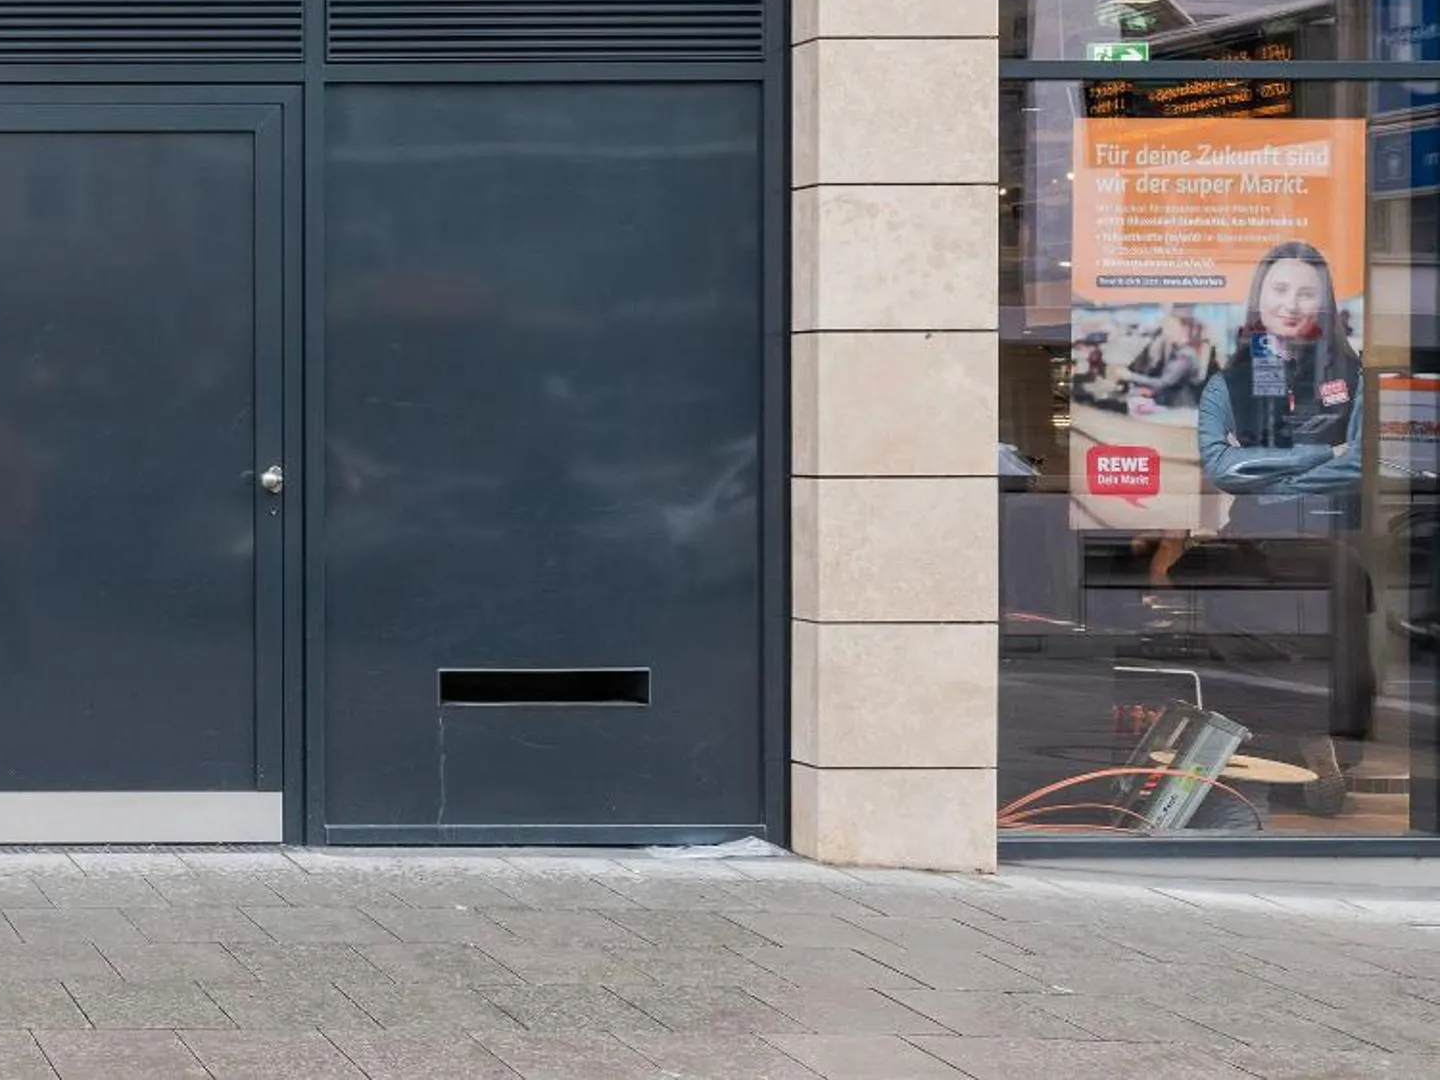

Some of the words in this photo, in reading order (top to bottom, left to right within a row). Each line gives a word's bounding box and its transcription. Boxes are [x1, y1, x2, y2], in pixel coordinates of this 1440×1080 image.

[1095, 143, 1129, 166] Für
[1135, 143, 1191, 166] deine
[1196, 143, 1280, 166] Zukunft
[1286, 143, 1329, 166] sind
[1096, 171, 1128, 193] wir
[1135, 171, 1170, 194] der
[1176, 177, 1233, 199] super
[1240, 172, 1309, 195] Markt.
[1097, 457, 1149, 472] REWE
